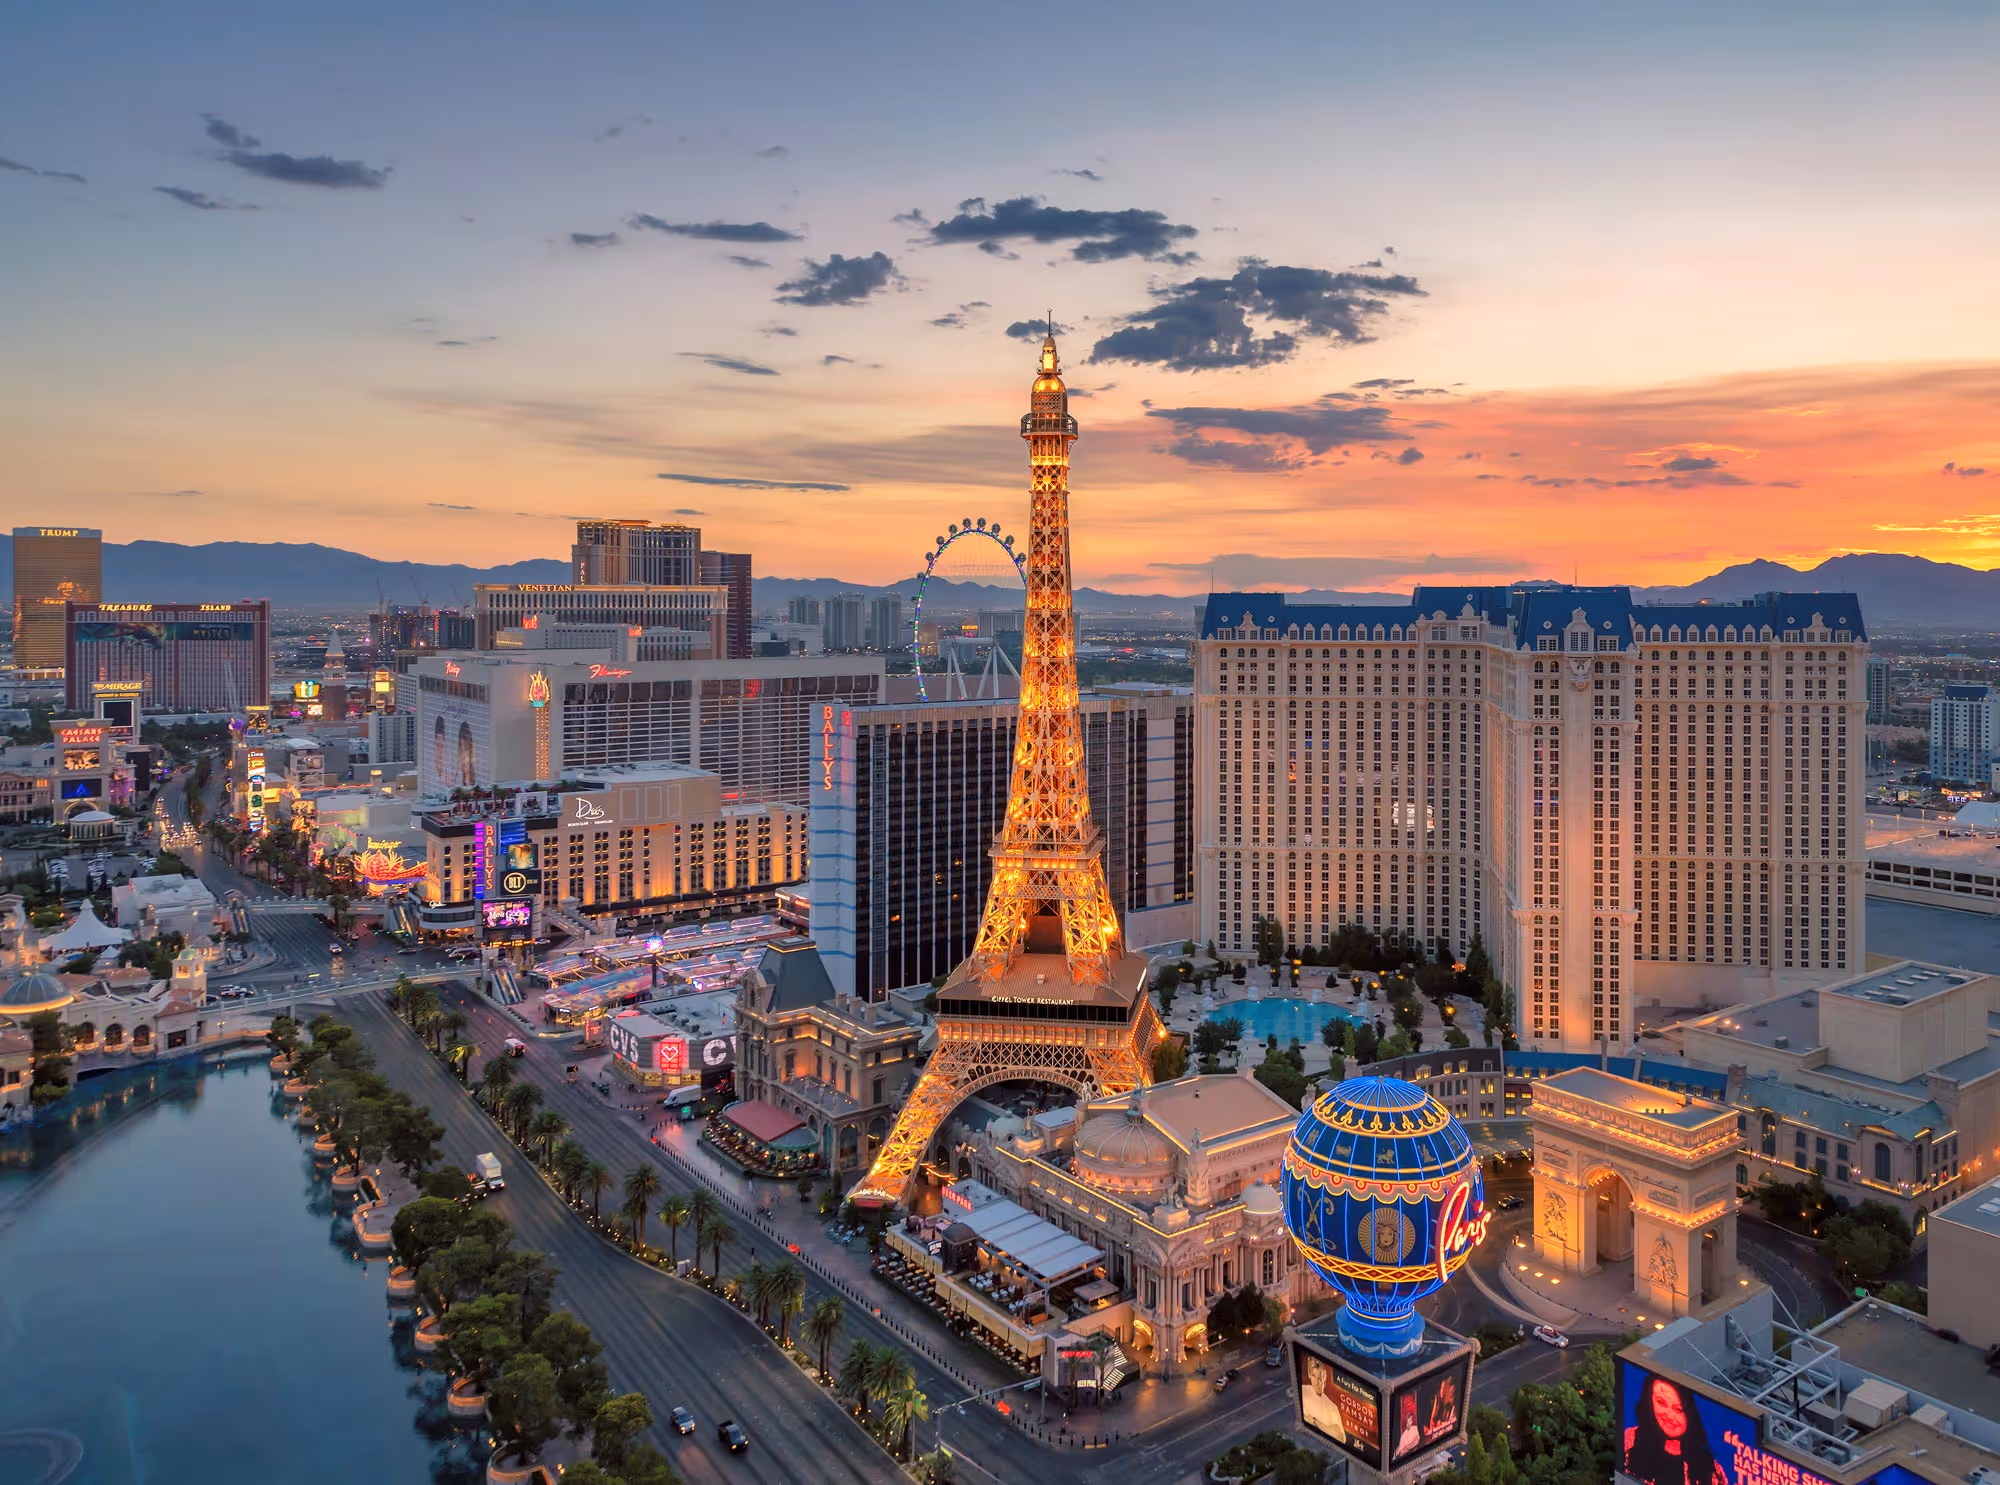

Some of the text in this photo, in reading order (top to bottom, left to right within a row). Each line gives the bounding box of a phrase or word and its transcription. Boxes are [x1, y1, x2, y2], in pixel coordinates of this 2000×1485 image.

[518, 584, 572, 592] VENETIAN
[103, 682, 141, 690] MIRAGE
[61, 728, 103, 736] CAESARS
[62, 736, 101, 744] PALACE
[508, 877, 522, 889] BLT
[992, 995, 1074, 1006] EIFFEL TOWER RESTAURANT
[610, 1023, 639, 1063] CVS
[703, 1036, 737, 1067] C
[942, 1186, 973, 1211] BEER PARK
[1439, 1181, 1492, 1283] Paris
[1340, 1393, 1373, 1418] GORDON
[1340, 1403, 1373, 1427] RAMSAY
[1734, 1453, 1760, 1475] HAS
